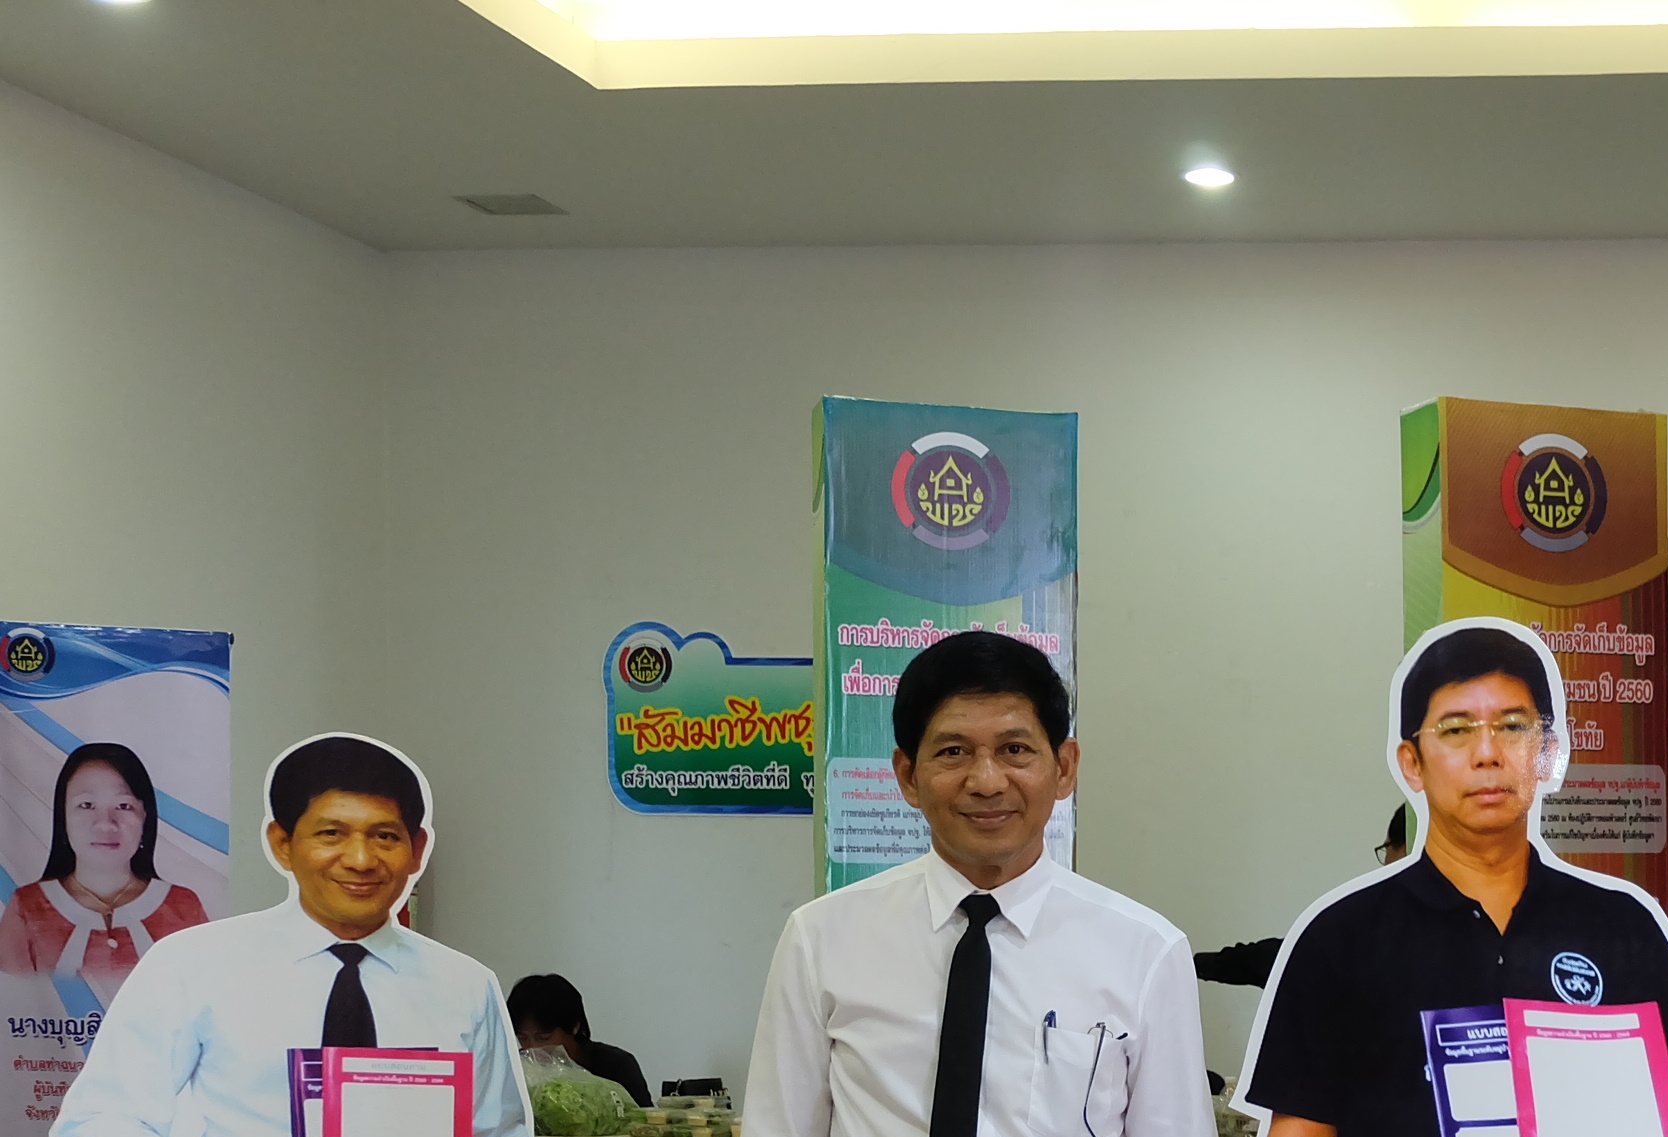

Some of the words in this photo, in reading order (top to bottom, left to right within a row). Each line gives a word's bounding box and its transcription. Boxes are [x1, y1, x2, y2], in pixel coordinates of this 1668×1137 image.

[1617, 681, 1653, 702] 2560
[623, 762, 789, 793] สร้างคุณภาพชีวิตที่ดี
